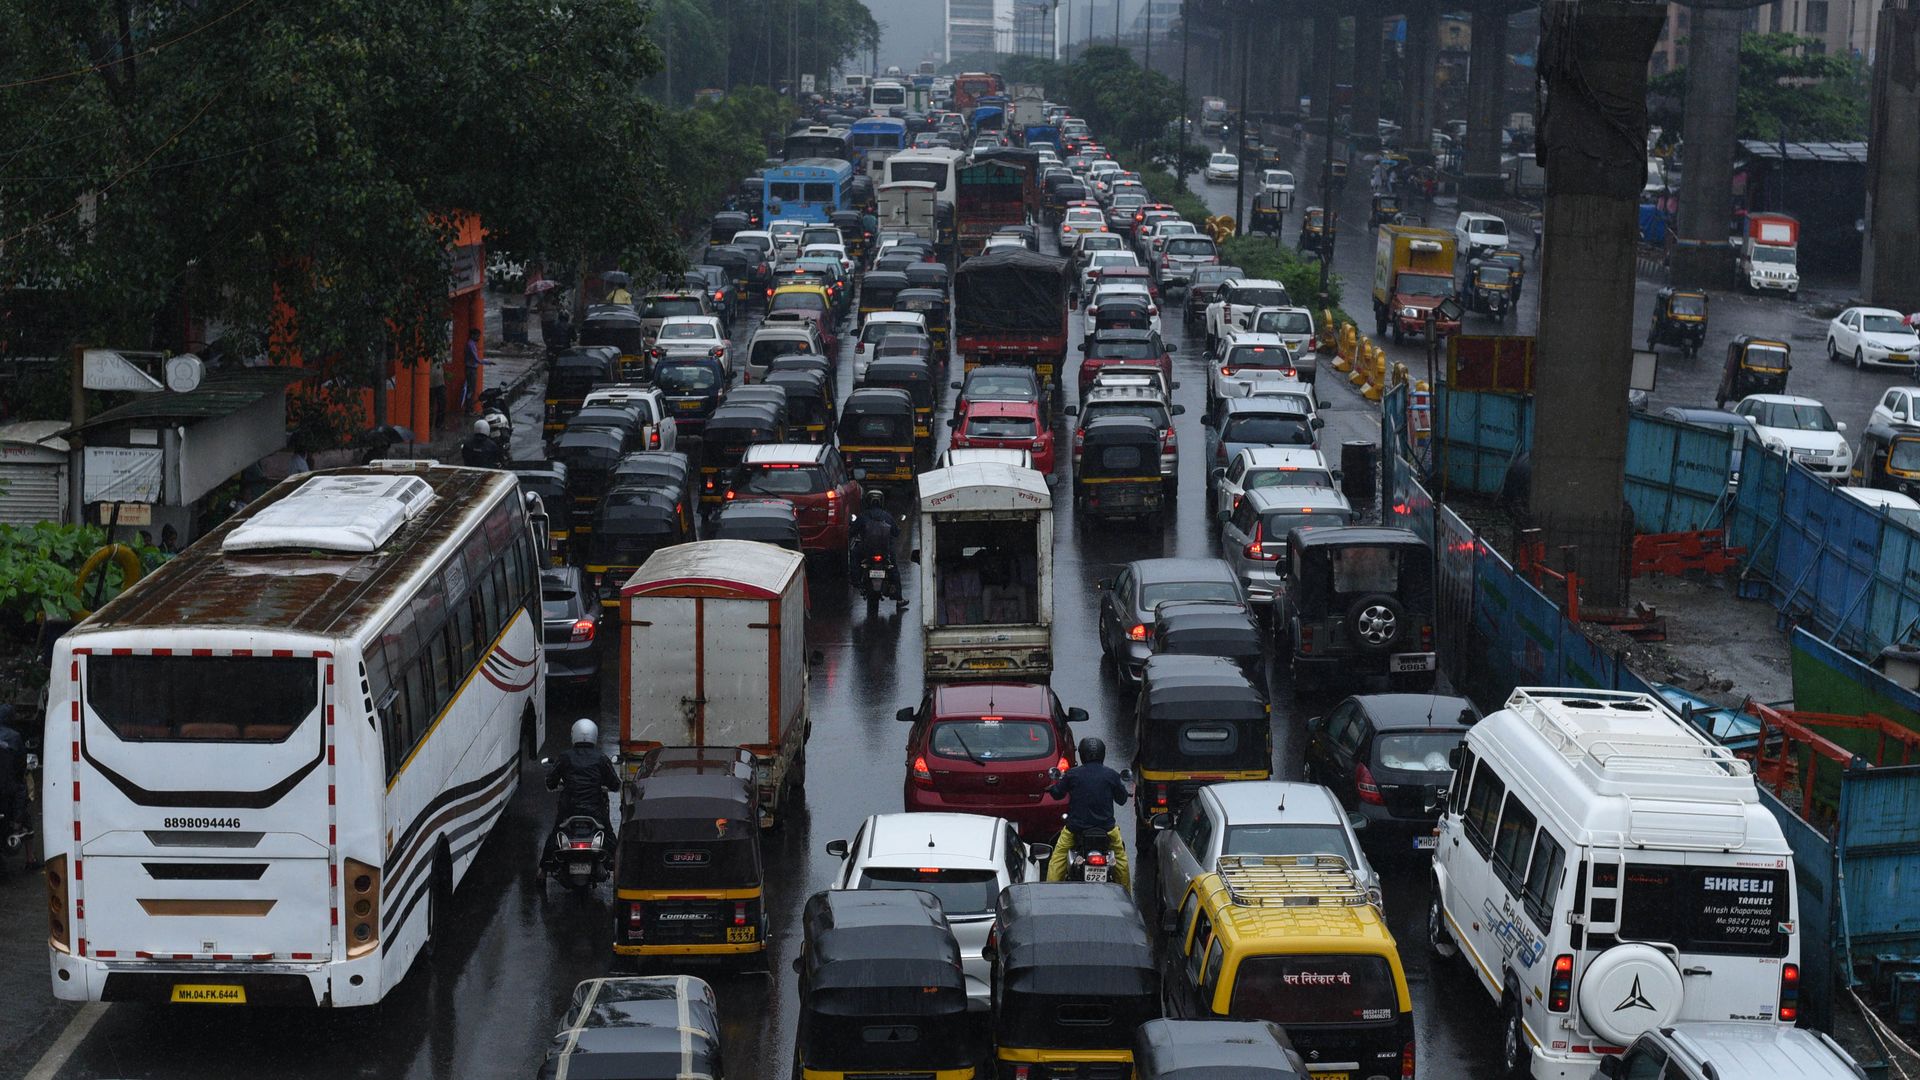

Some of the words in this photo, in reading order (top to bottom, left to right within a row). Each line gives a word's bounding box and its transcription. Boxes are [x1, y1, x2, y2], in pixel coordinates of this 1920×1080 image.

[86, 373, 119, 387] Kurar
[164, 817, 241, 829] 8898094446
[1704, 876, 1774, 893] SHREEJI
[1738, 896, 1773, 905] TRAVELS
[1703, 905, 1728, 914] Mitesh
[1503, 893, 1535, 945] TRAVELLER
[1750, 918, 1770, 926] 10164
[1725, 926, 1748, 934] 99745
[1749, 927, 1771, 935] 74406
[1283, 974, 1299, 985] धन
[1301, 972, 1335, 985] निरंकार
[1337, 972, 1351, 985] जी
[178, 989, 239, 1000] MH.04.FK.6444
